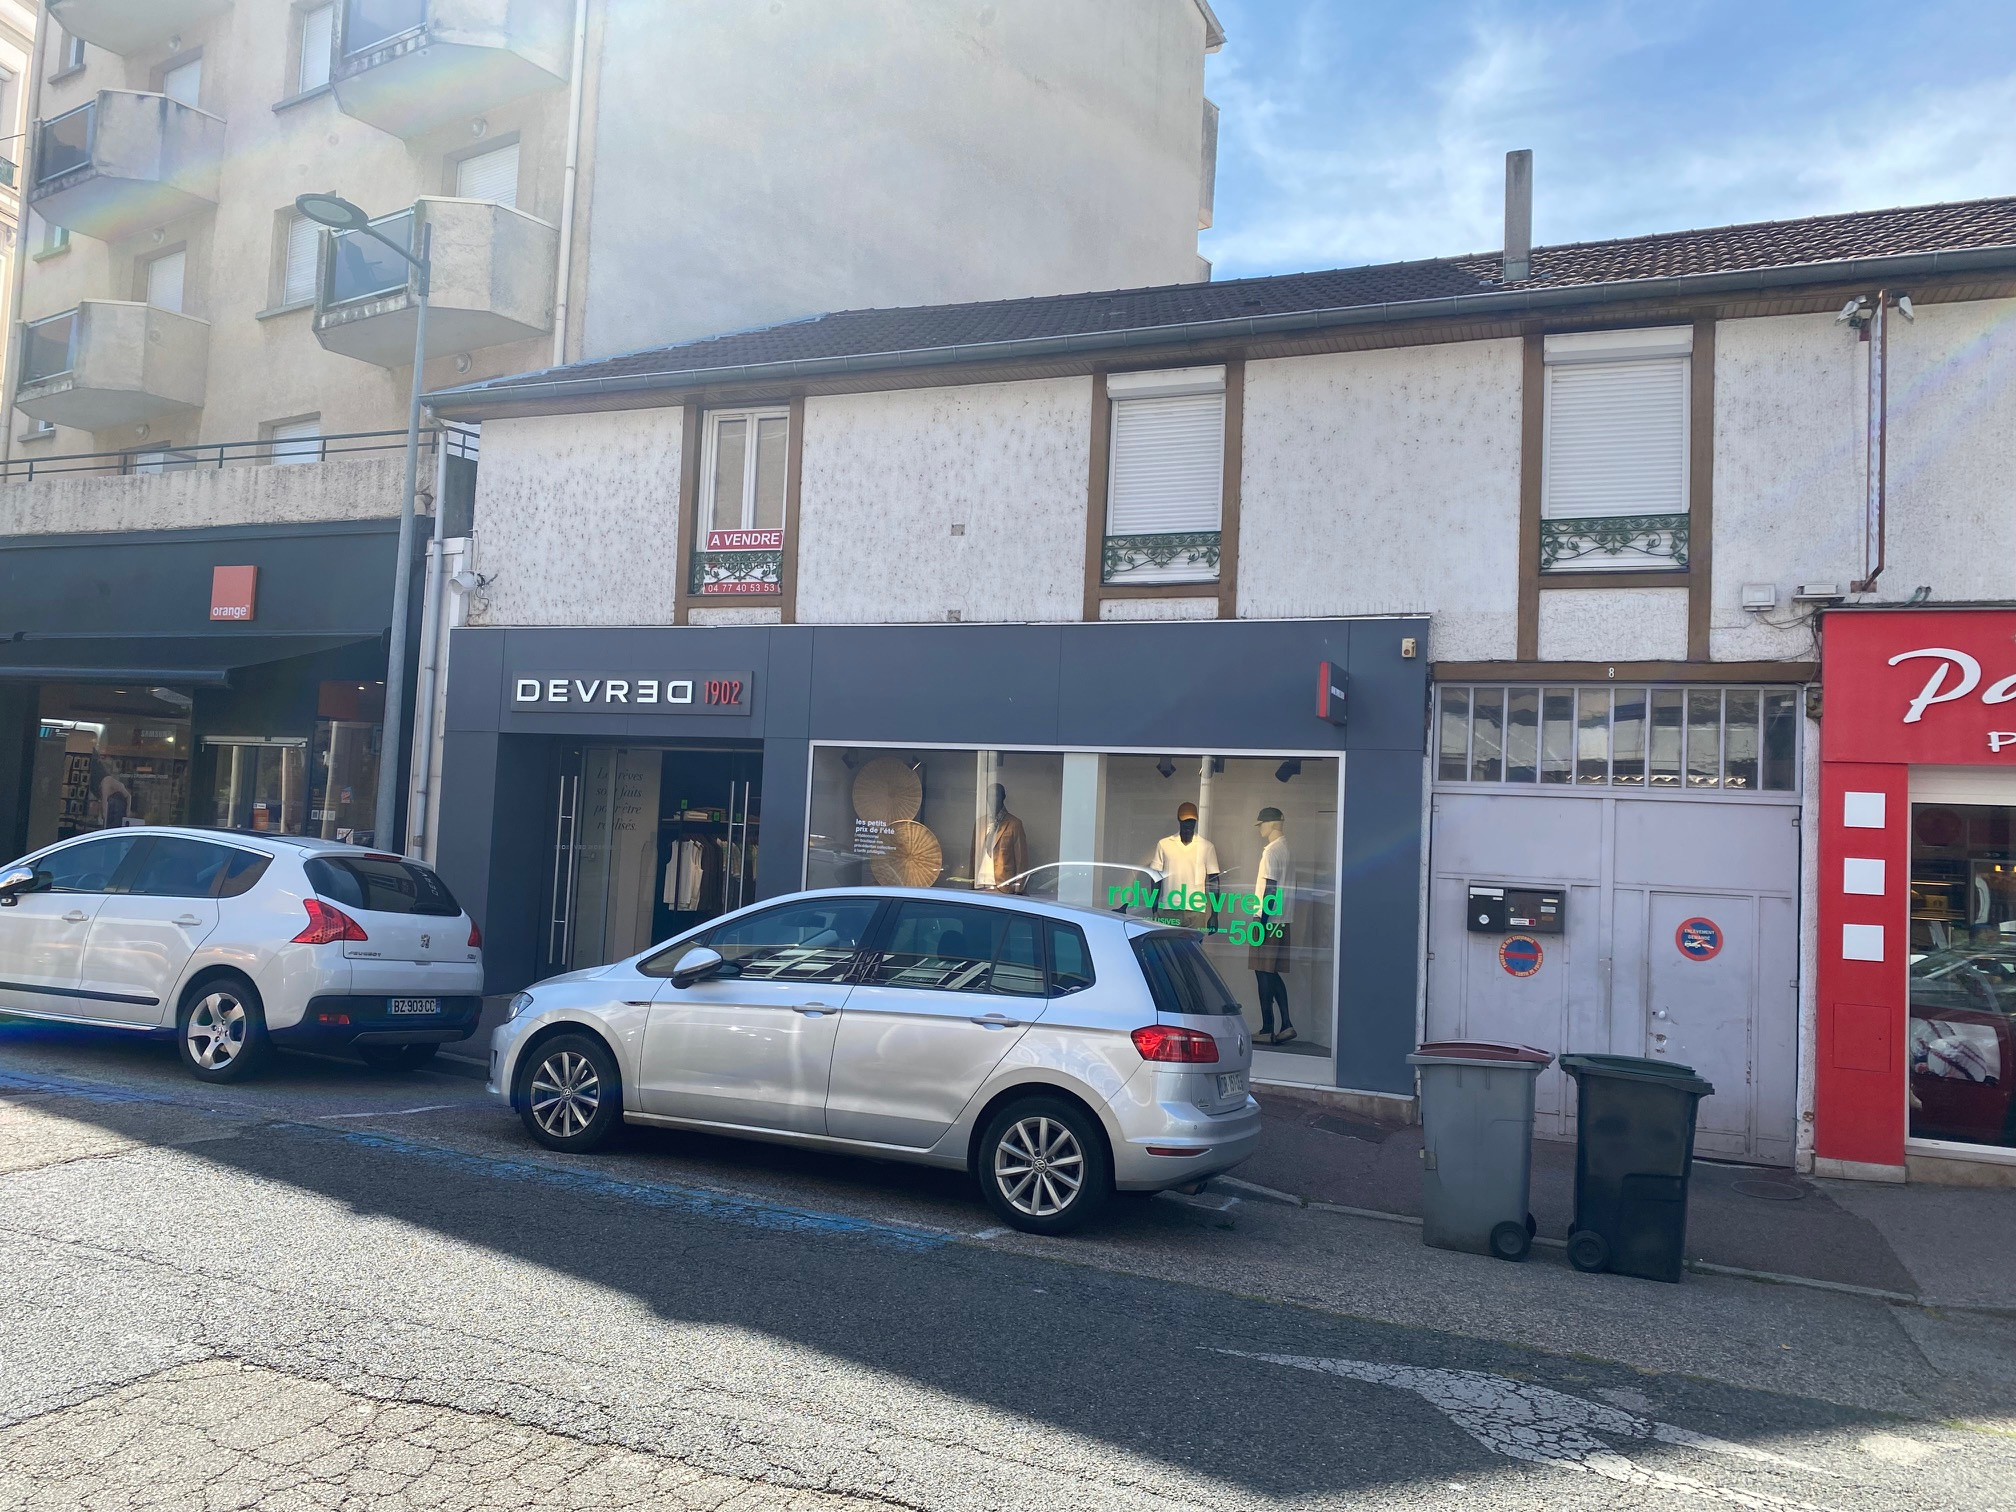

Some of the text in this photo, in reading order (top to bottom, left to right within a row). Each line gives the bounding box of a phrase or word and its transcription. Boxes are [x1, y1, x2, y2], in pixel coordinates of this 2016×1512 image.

[710, 532, 780, 546] A VENDRE
[708, 584, 775, 592] 04 77 40 53 53
[212, 606, 247, 618] orange
[1608, 667, 1615, 678] 8
[516, 680, 740, 704] DEVRED 1902
[1108, 880, 1283, 916] rdv.devred
